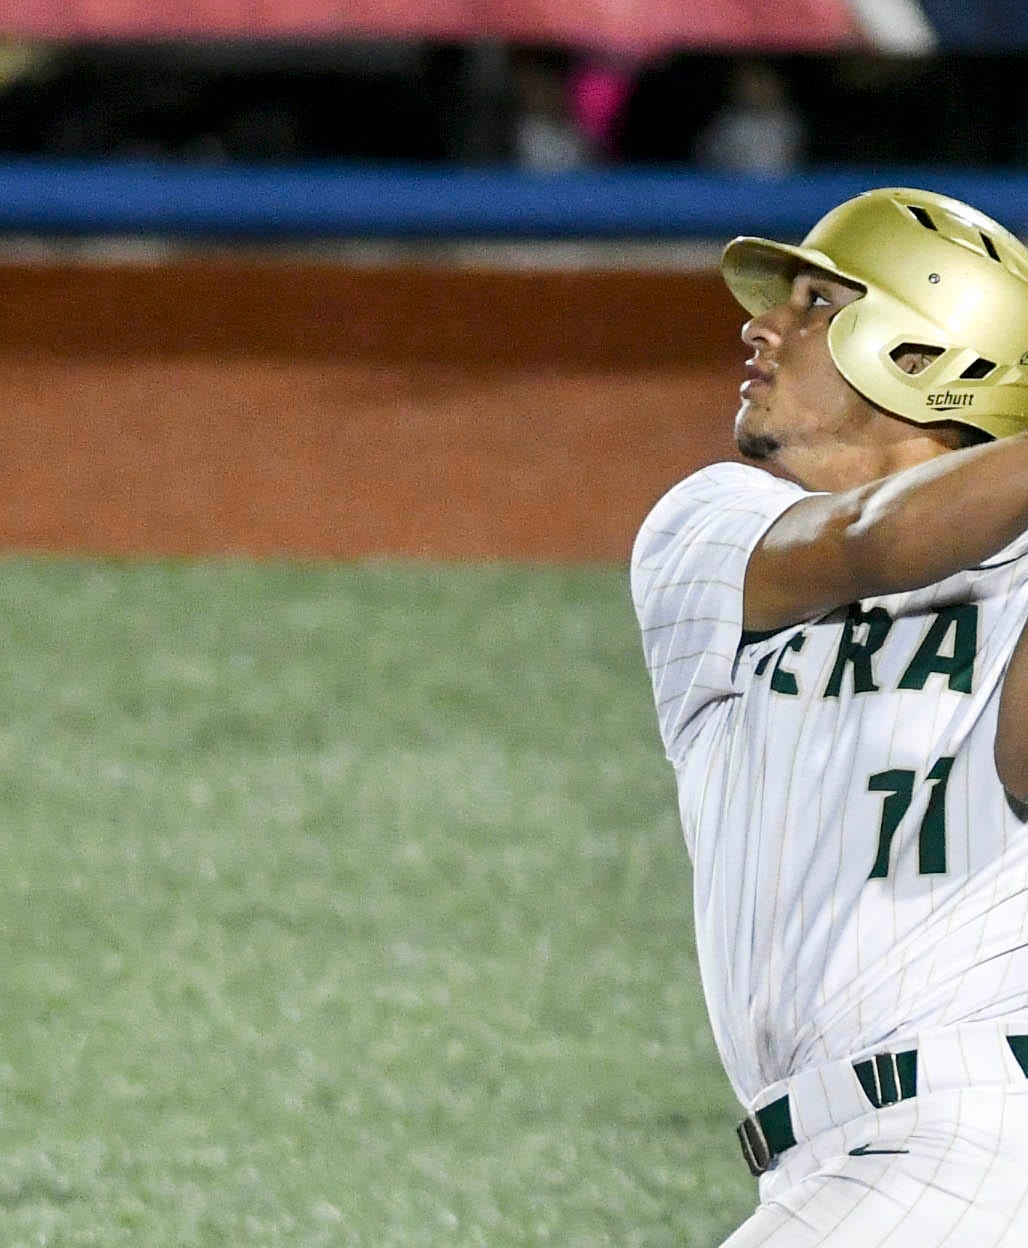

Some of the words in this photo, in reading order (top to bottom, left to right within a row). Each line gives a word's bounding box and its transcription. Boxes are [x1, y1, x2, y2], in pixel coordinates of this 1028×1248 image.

[926, 389, 974, 407] schutt
[754, 600, 979, 698] ERA
[867, 756, 956, 879] 71
